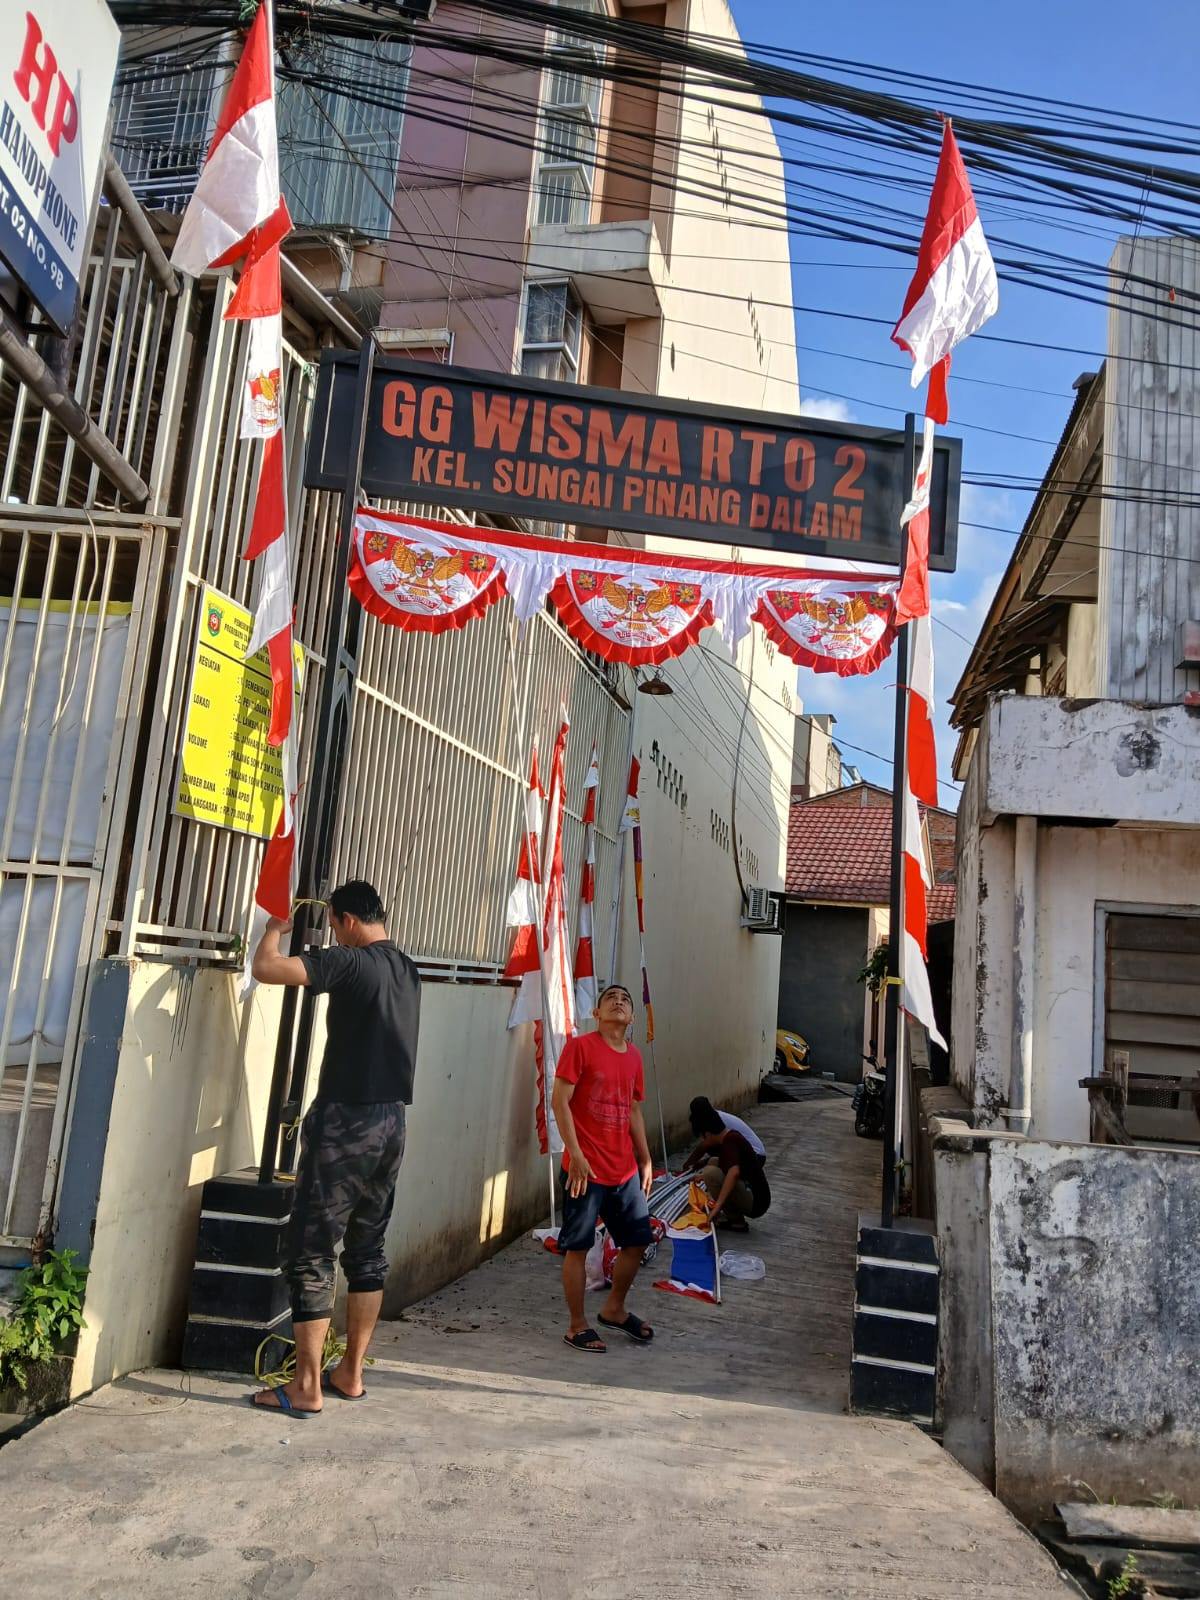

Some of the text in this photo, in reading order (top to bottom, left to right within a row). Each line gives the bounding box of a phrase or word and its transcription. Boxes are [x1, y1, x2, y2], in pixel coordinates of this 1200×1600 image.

[13, 11, 78, 158] HP
[0, 100, 78, 252] HANDPHONE
[11, 205, 26, 239] 02
[27, 227, 47, 270] NO.
[51, 262, 64, 290] 9B
[382, 381, 453, 444] GG
[472, 391, 682, 477] WISMA
[411, 446, 862, 541] KEL. SUNGAI PINANG DALAM
[188, 734, 208, 749] VOLUME
[194, 694, 211, 709] LOKASI
[182, 774, 203, 788] SUMBER
[203, 781, 216, 793] DANA
[193, 798, 218, 813] ANGGARAN
